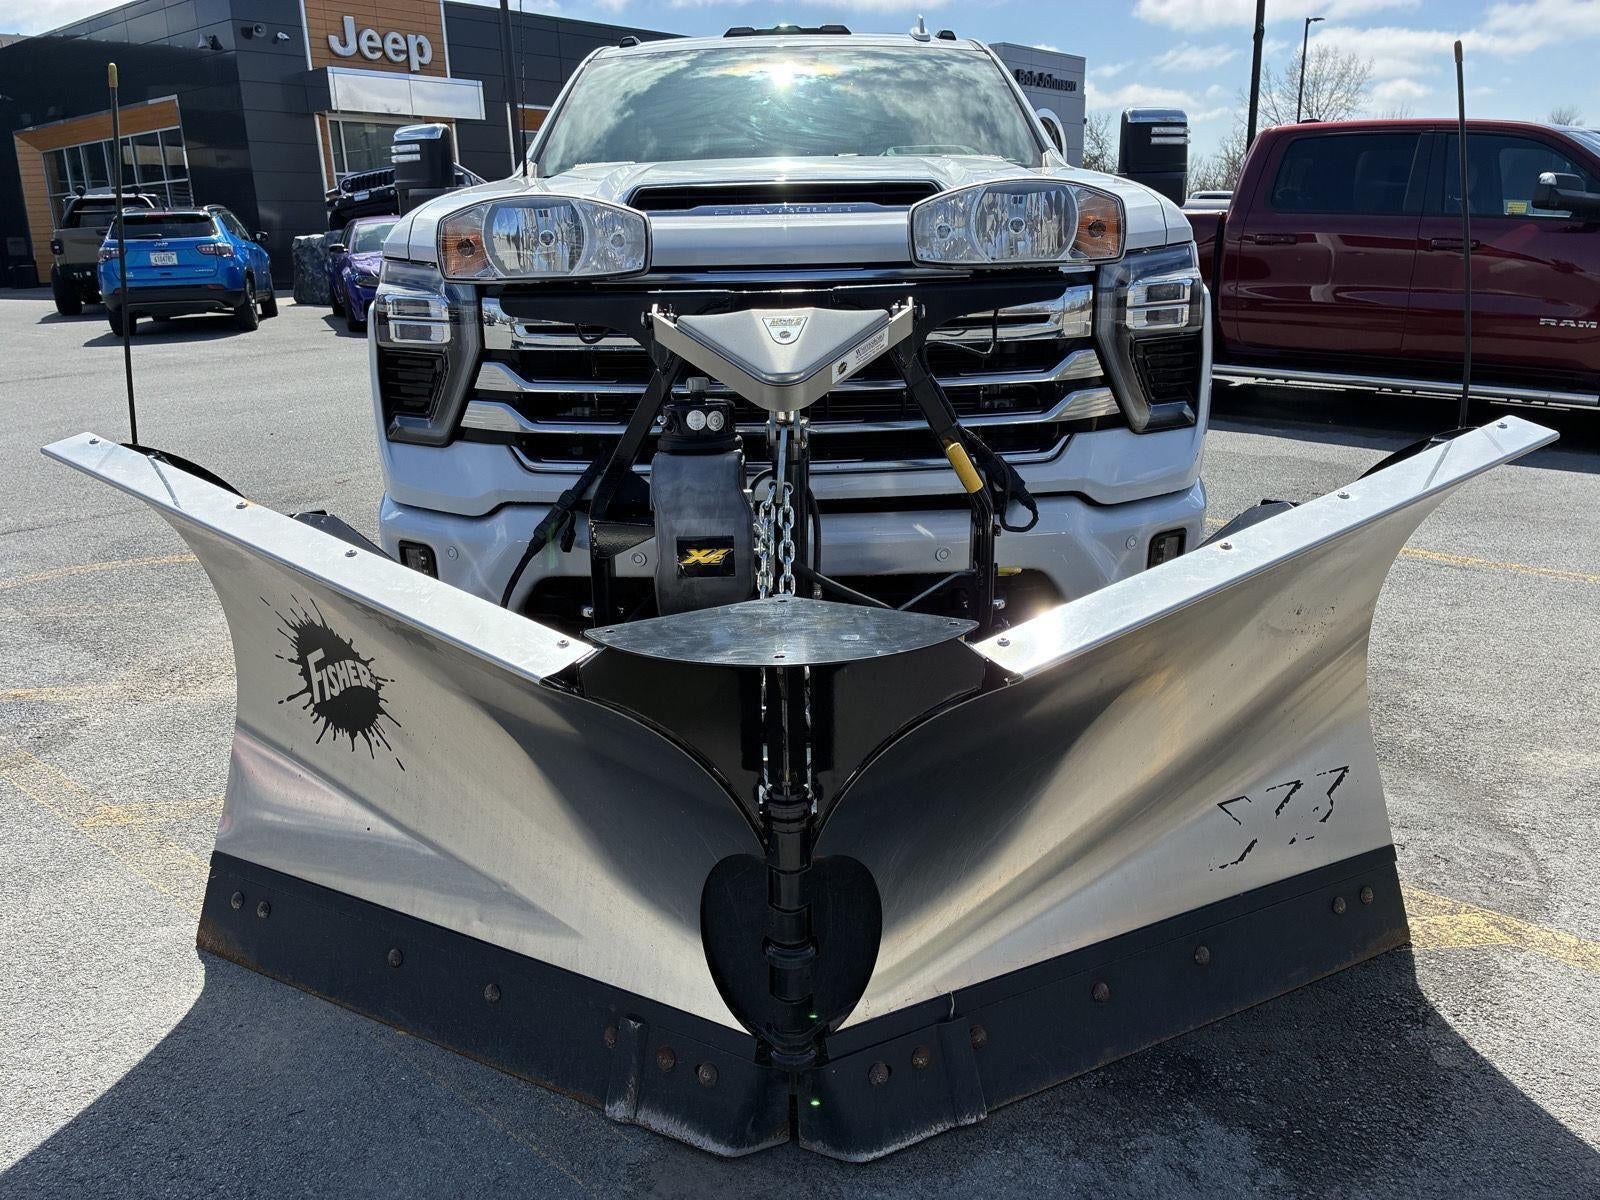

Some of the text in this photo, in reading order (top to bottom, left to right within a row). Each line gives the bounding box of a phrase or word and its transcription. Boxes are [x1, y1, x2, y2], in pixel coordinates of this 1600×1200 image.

[328, 15, 433, 72] Jeep
[1016, 68, 1077, 91] Bob Johnson
[1539, 317, 1598, 329] RAM
[306, 647, 376, 704] FISHER
